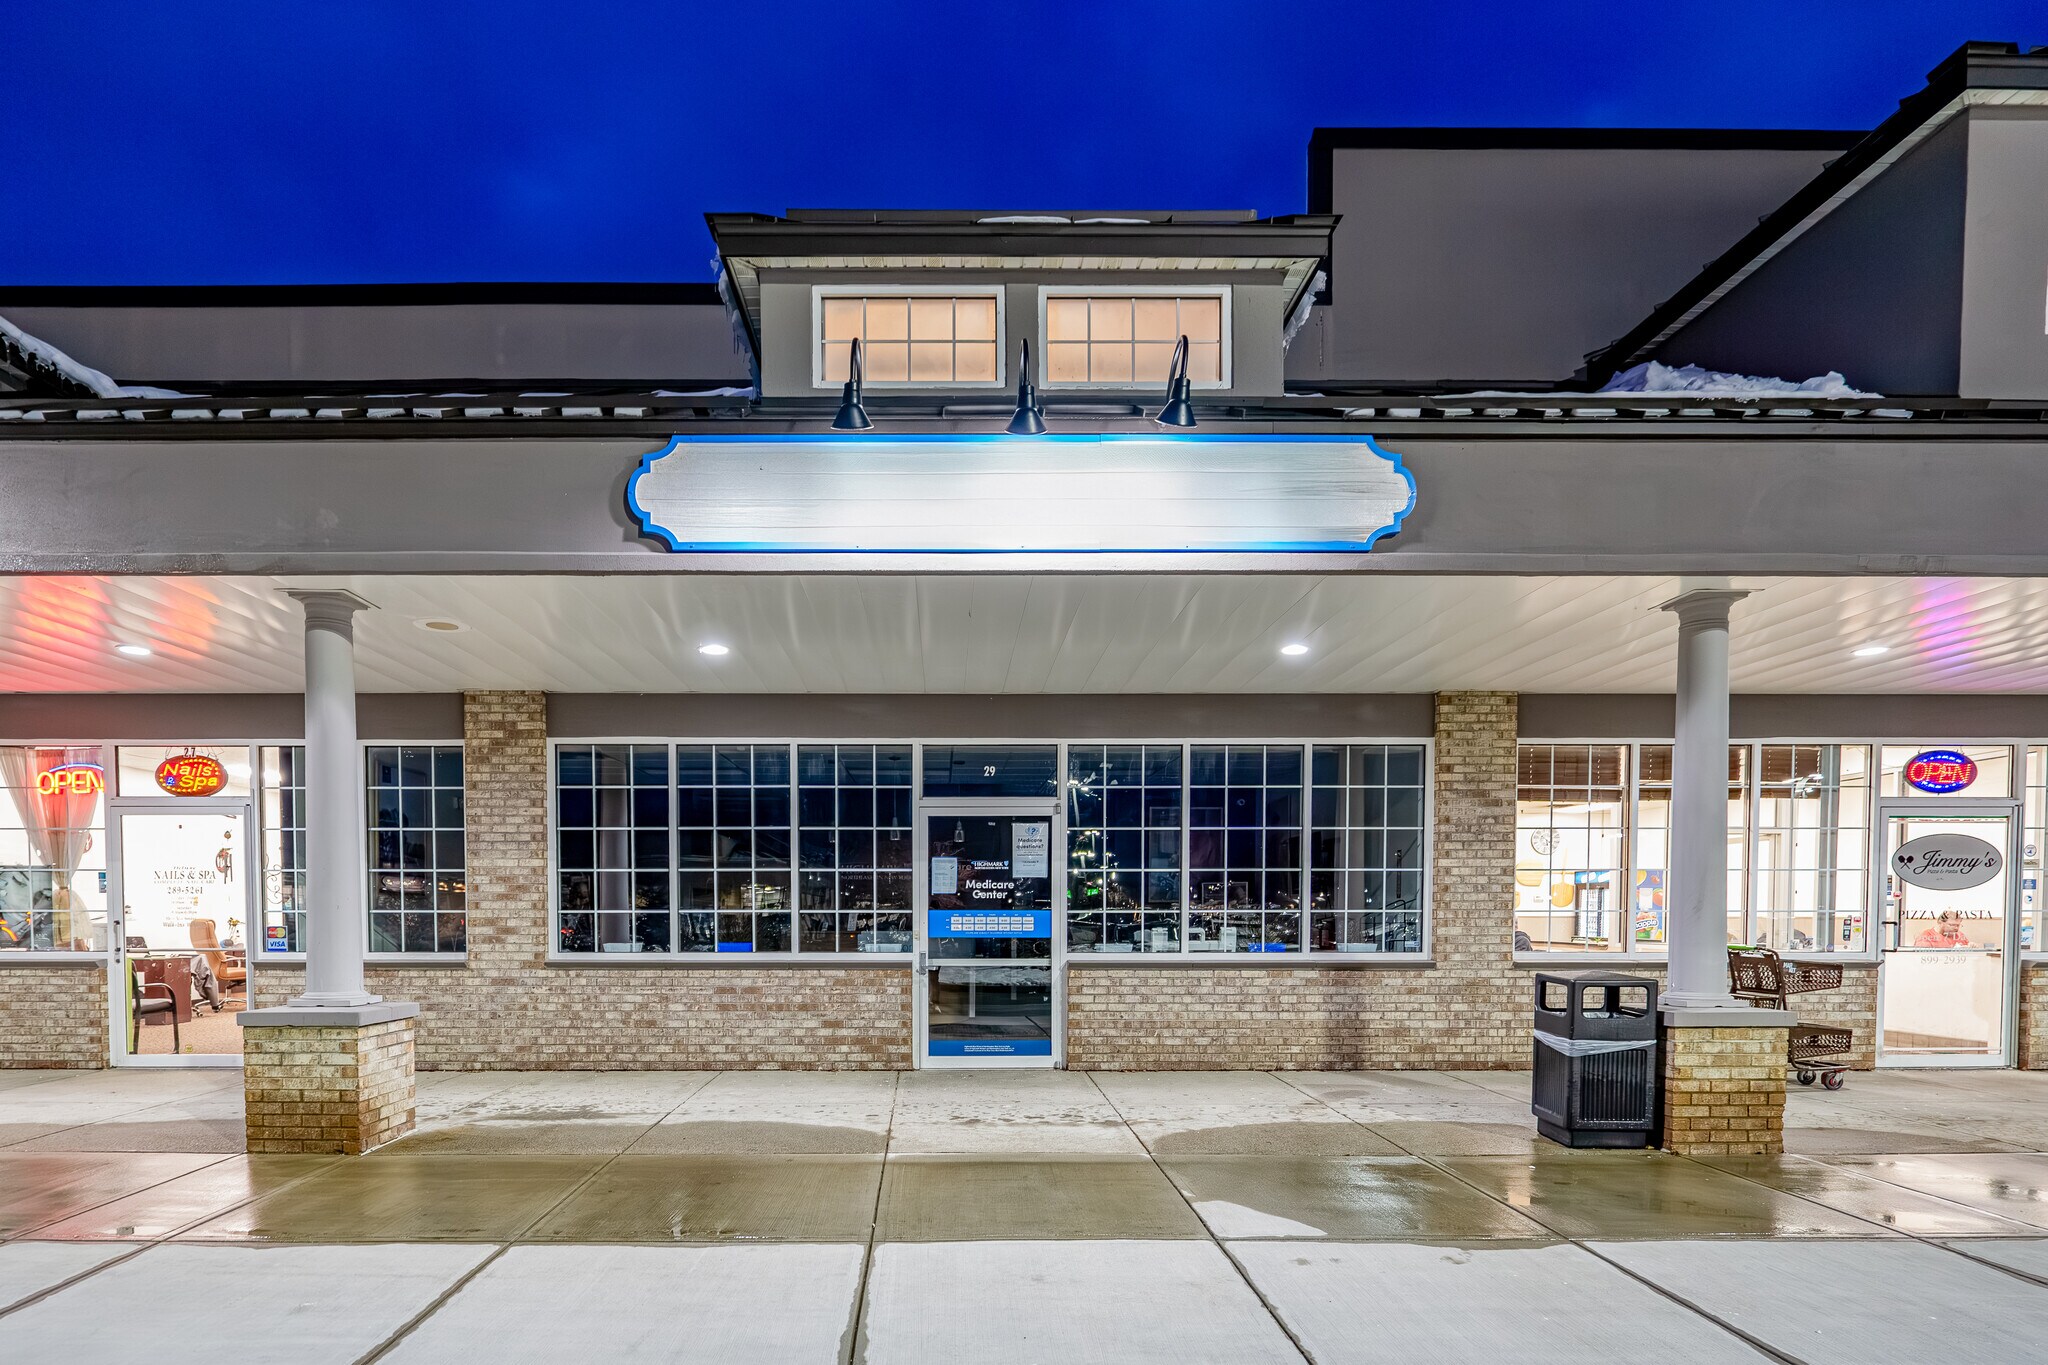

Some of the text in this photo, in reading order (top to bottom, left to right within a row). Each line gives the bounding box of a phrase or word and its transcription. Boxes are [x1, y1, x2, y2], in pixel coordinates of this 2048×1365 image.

[183, 747, 197, 758] 27
[162, 762, 212, 777] Nails
[983, 766, 996, 777] 29
[1909, 761, 1972, 784] OPEN
[36, 770, 105, 795] OPEN
[179, 774, 218, 791] Spa
[1912, 849, 1998, 875] Jimmy's
[153, 870, 217, 880] NAILS & SPA
[965, 879, 1015, 889] Medicare
[167, 886, 204, 895] 289-5261
[972, 889, 1008, 899] Center
[1899, 910, 1936, 920] PIZZA
[1956, 910, 1993, 920] PASTA
